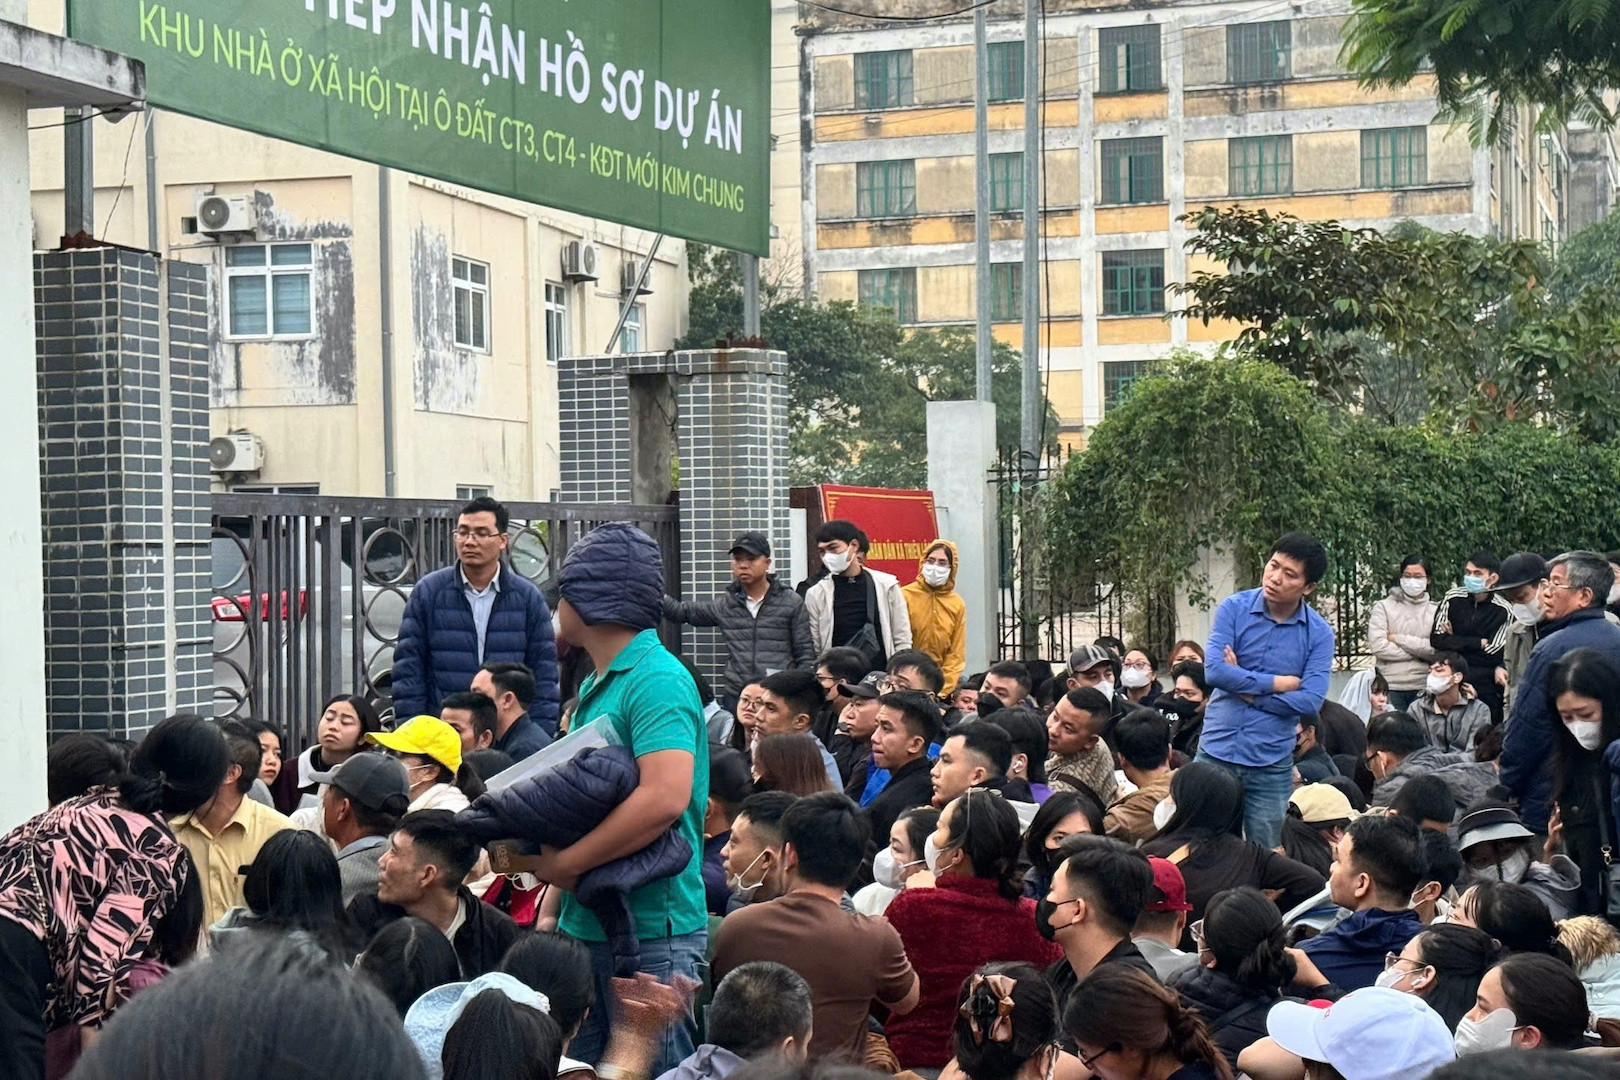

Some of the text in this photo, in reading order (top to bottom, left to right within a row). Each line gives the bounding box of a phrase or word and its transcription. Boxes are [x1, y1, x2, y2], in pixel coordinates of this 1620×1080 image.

[139, 0, 204, 58] KHU
[213, 24, 276, 80] NHÀ
[280, 36, 303, 86] Ở
[308, 53, 343, 101] XÃ
[348, 66, 390, 120] HỘI
[395, 82, 428, 131] TẠI
[434, 89, 451, 131] Ô
[455, 98, 496, 144] ĐẤT
[500, 117, 538, 161] CT3,
[543, 130, 576, 167] CT4
[591, 143, 623, 178] KĐT
[627, 152, 658, 190] MỚI
[663, 164, 689, 198] KIM
[693, 174, 743, 212] CHUNG
[411, 0, 526, 87] NHẬN
[541, 30, 590, 103] HỒ
[601, 63, 644, 120] SƠ
[655, 80, 699, 149] DỰ
[705, 89, 742, 154] ÁN
